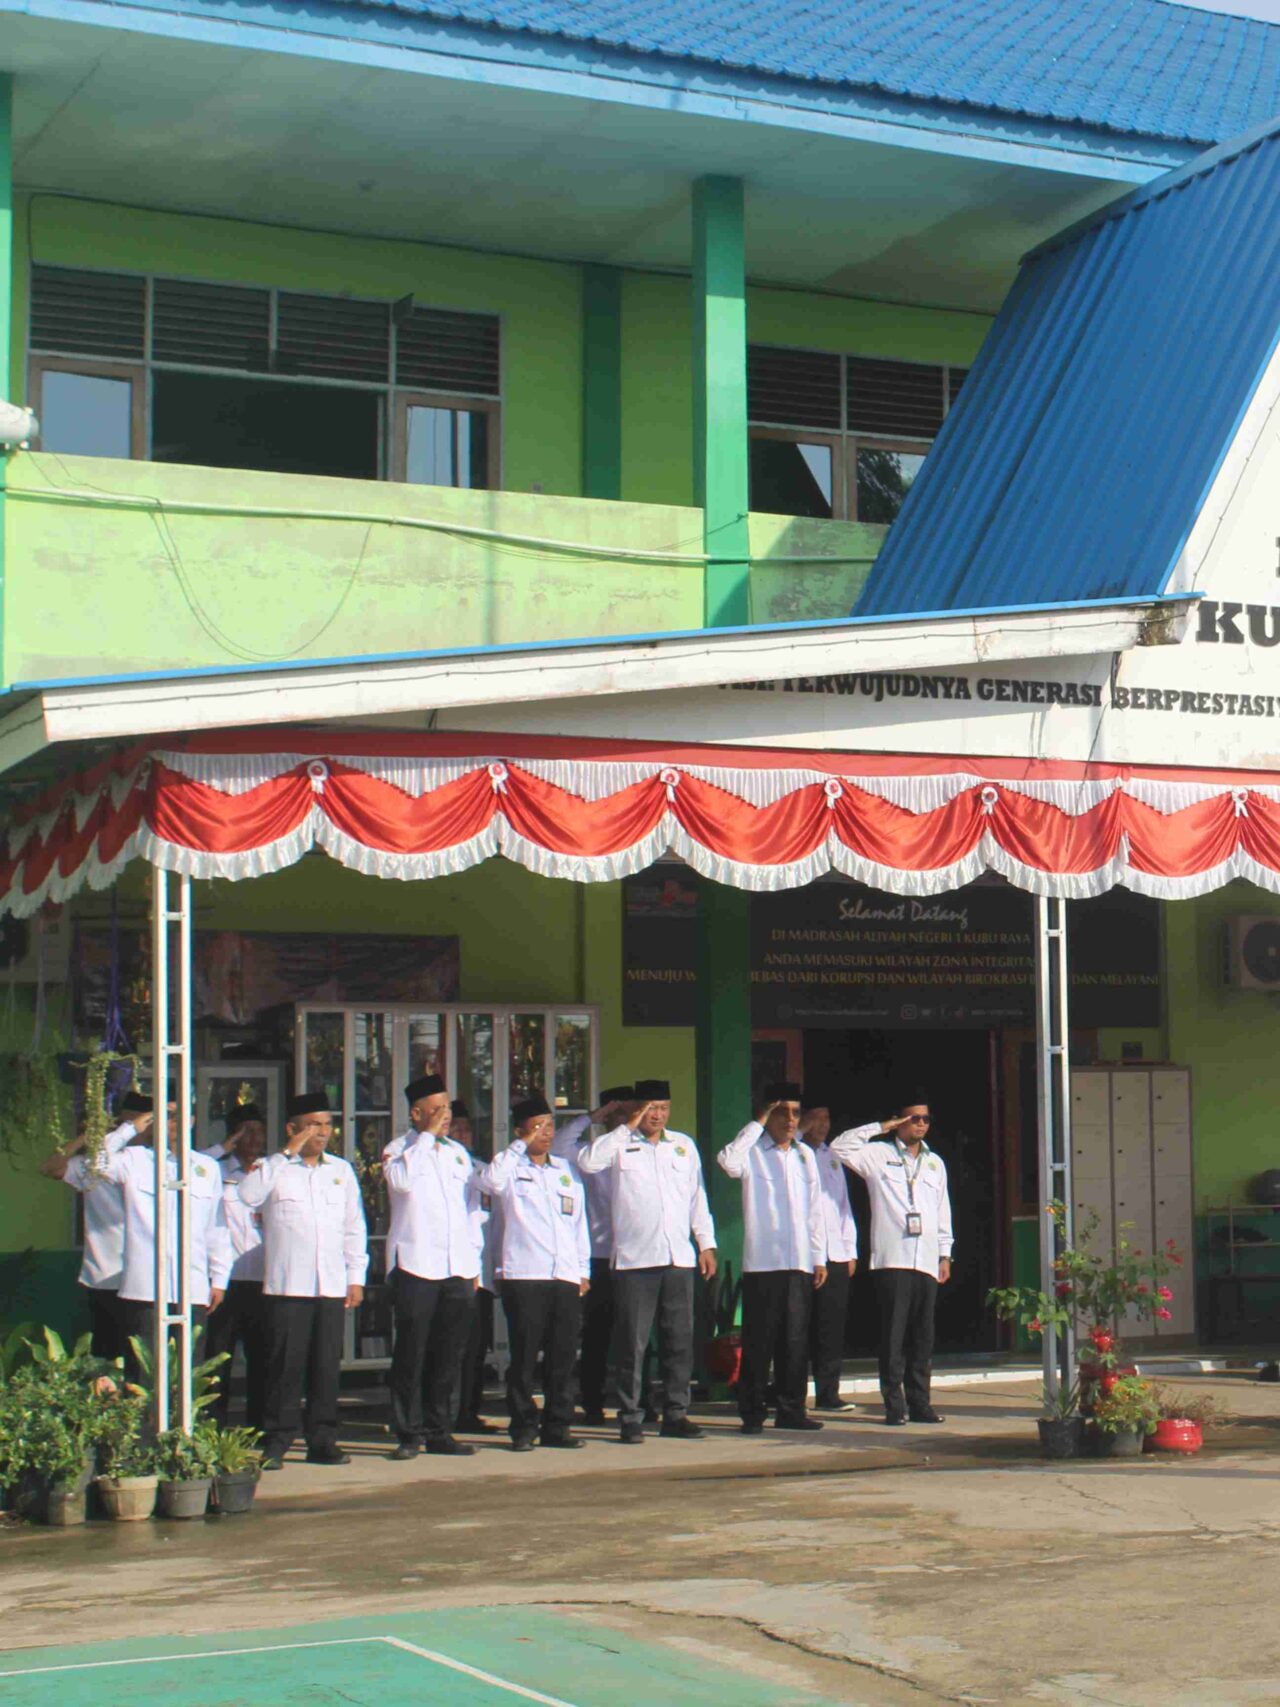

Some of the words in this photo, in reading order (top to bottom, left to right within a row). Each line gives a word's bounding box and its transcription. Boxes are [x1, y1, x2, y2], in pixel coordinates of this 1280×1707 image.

[976, 677, 1102, 707] GENERASI
[839, 898, 905, 921] Selamat
[910, 900, 968, 929] Datang
[771, 930, 785, 941] DI
[787, 930, 860, 942] MADRASAH
[863, 931, 905, 943] ALIYAH
[908, 932, 952, 943] NEGERI
[765, 953, 801, 965] ANDA
[874, 955, 931, 967] WILAYAH
[933, 955, 969, 967] ZONA
[626, 969, 685, 984] MENUJU
